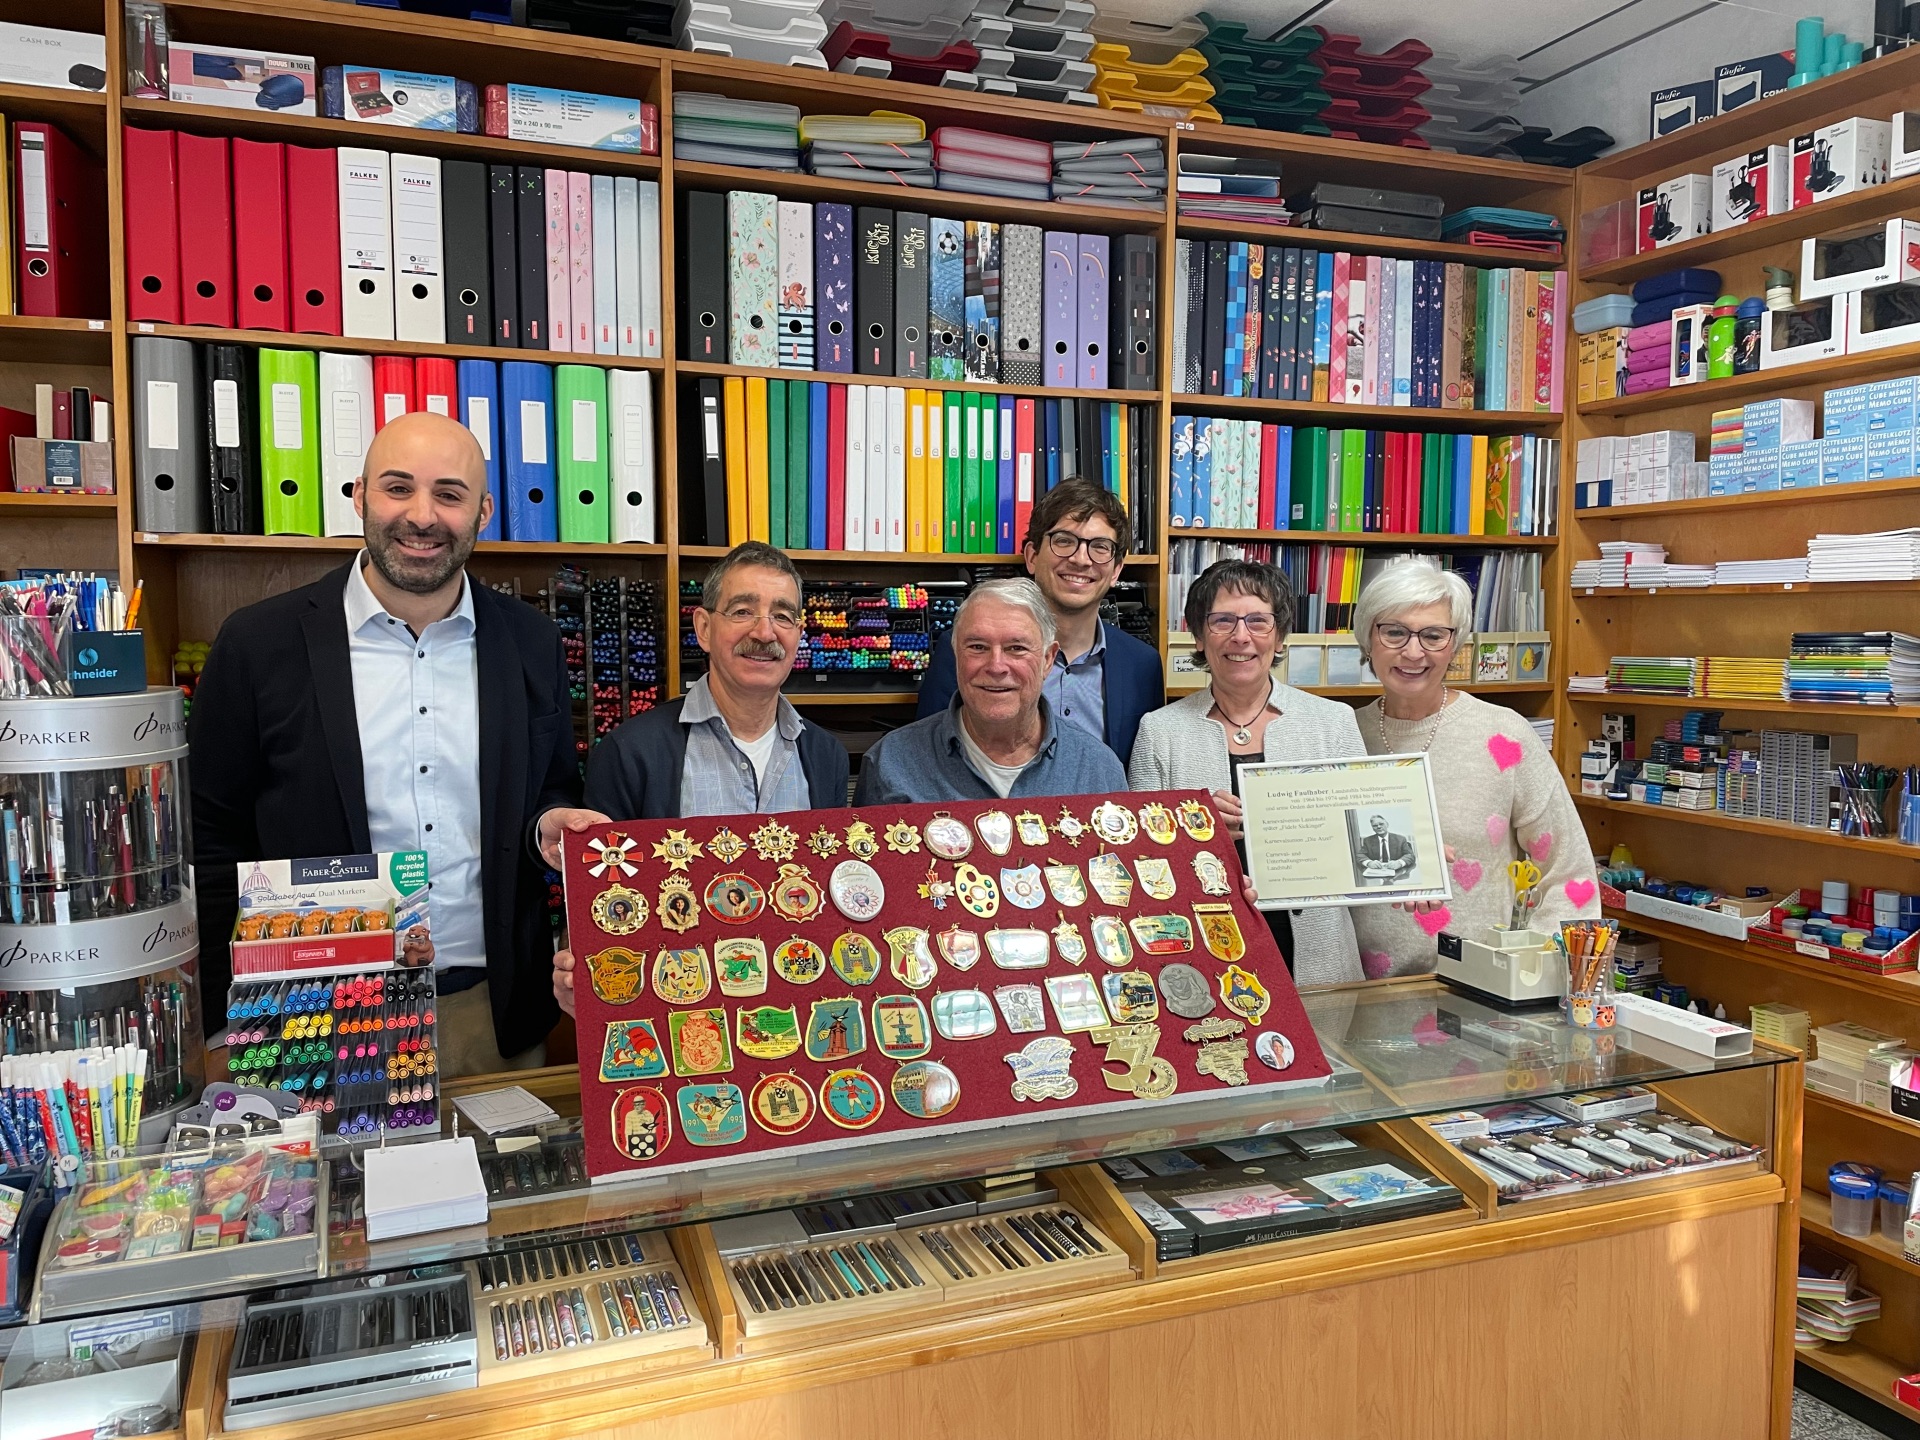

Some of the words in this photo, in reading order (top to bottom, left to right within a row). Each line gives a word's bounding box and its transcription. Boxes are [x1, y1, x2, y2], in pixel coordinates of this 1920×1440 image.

[20, 36, 42, 44] CASH
[1869, 379, 1912, 392] ZETTELKLOTZ
[1825, 387, 1867, 399] ZETTELKLOTZ
[1744, 401, 1780, 412] ZETTELKLOTZ
[1869, 400, 1891, 408] MEMO
[1893, 397, 1912, 405] CUBE
[1825, 407, 1846, 415] MEMO
[1848, 404, 1866, 412] CUBE
[1868, 429, 1911, 441] ZETTELKLOTZ
[1782, 441, 1820, 451] ZETTELKLOTZ
[1822, 435, 1864, 447] ZETTELKLOTZ
[1710, 453, 1742, 462] ZETTELKLO
[1743, 447, 1779, 458] ZETTELKLOTZ
[1823, 455, 1844, 463] MEMO
[1845, 452, 1863, 460] CUBE
[1868, 449, 1890, 458] MEMO
[1892, 446, 1910, 454] CUBE
[1763, 462, 1778, 470] CUBE
[1782, 460, 1801, 468] MEMO
[1802, 457, 1818, 465] CUBE
[20, 730, 91, 745] PARKER
[1294, 789, 1328, 797] Faulhaber
[405, 854, 417, 862] 100
[302, 865, 370, 877] FABER-CASTELL
[396, 862, 425, 871] recycled
[402, 870, 425, 879] plastic
[337, 888, 366, 896] Markers
[30, 948, 100, 964] PARKER
[111, 1150, 119, 1158] M
[1258, 1229, 1299, 1242] FABER-CASTELL
[410, 1369, 456, 1384] LAMY
